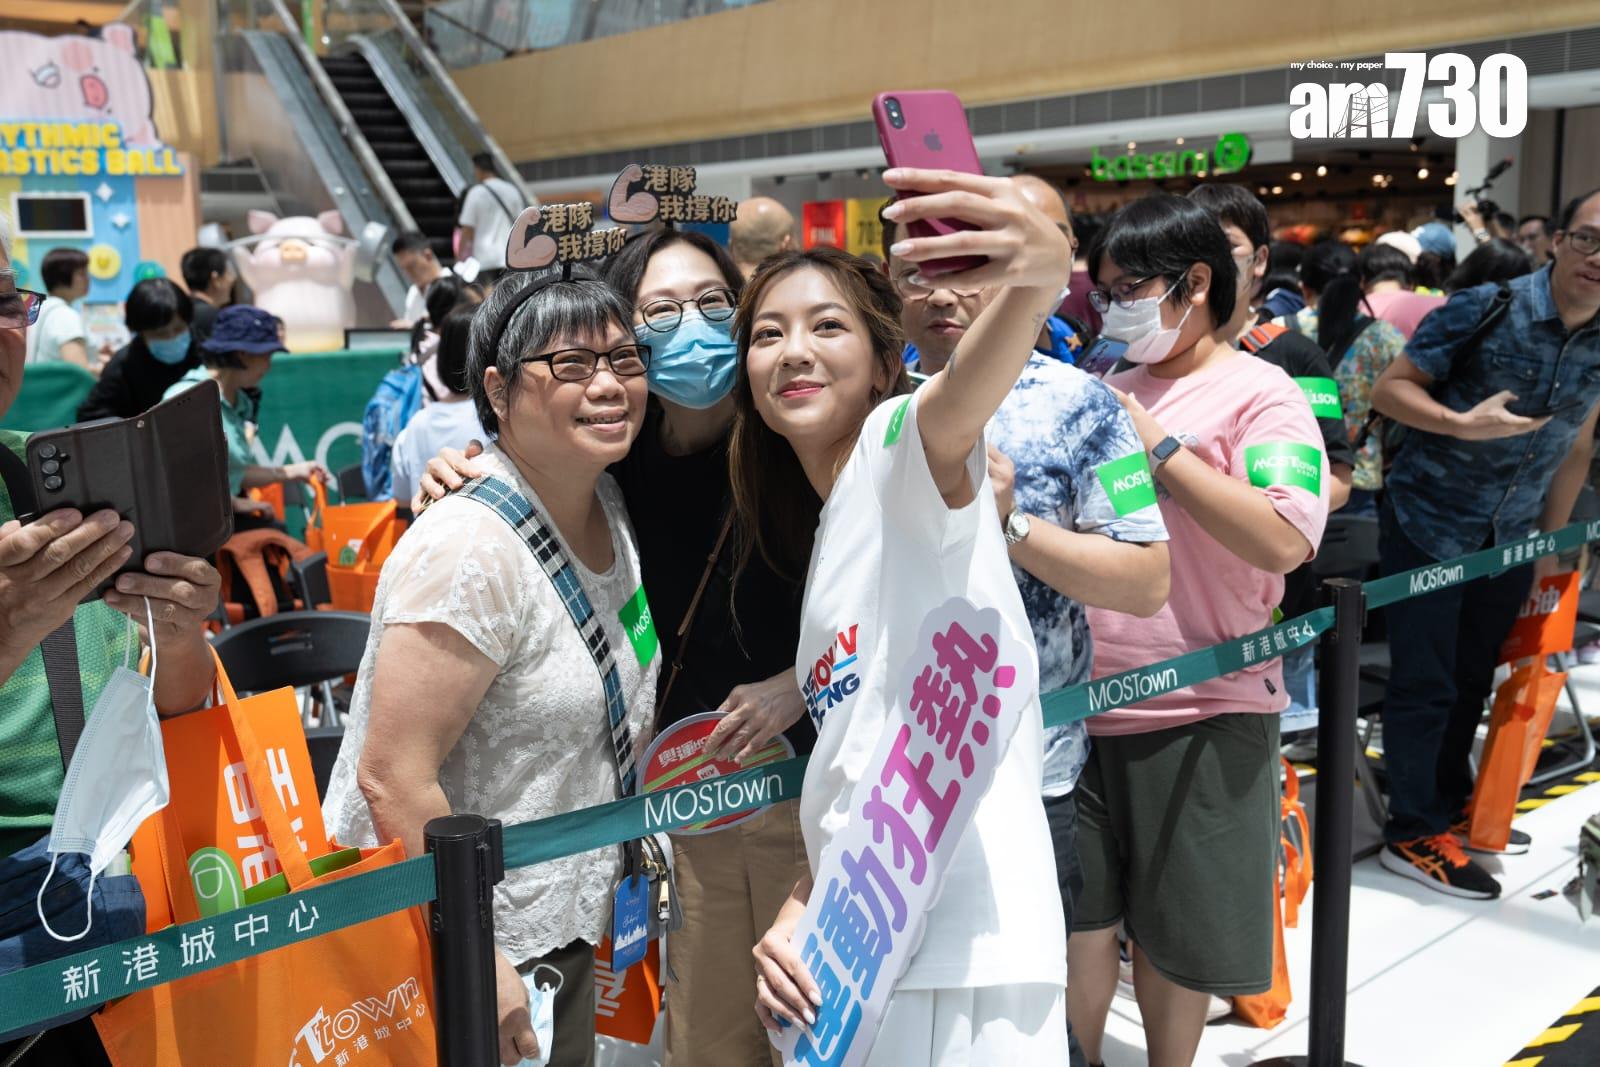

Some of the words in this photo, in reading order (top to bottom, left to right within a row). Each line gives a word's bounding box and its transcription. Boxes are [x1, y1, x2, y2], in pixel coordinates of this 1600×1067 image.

[0, 123, 121, 148] YTHMIC
[106, 150, 181, 176] BALL
[643, 165, 697, 193] 港隊
[542, 202, 594, 234] 港隊
[659, 195, 738, 223] 我撐你
[558, 227, 628, 262] 我撐你
[1410, 564, 1464, 594] MOSTown
[1088, 668, 1178, 712] MOSTown
[645, 774, 783, 829] MOSTown
[62, 899, 320, 1003] 新港城中心
